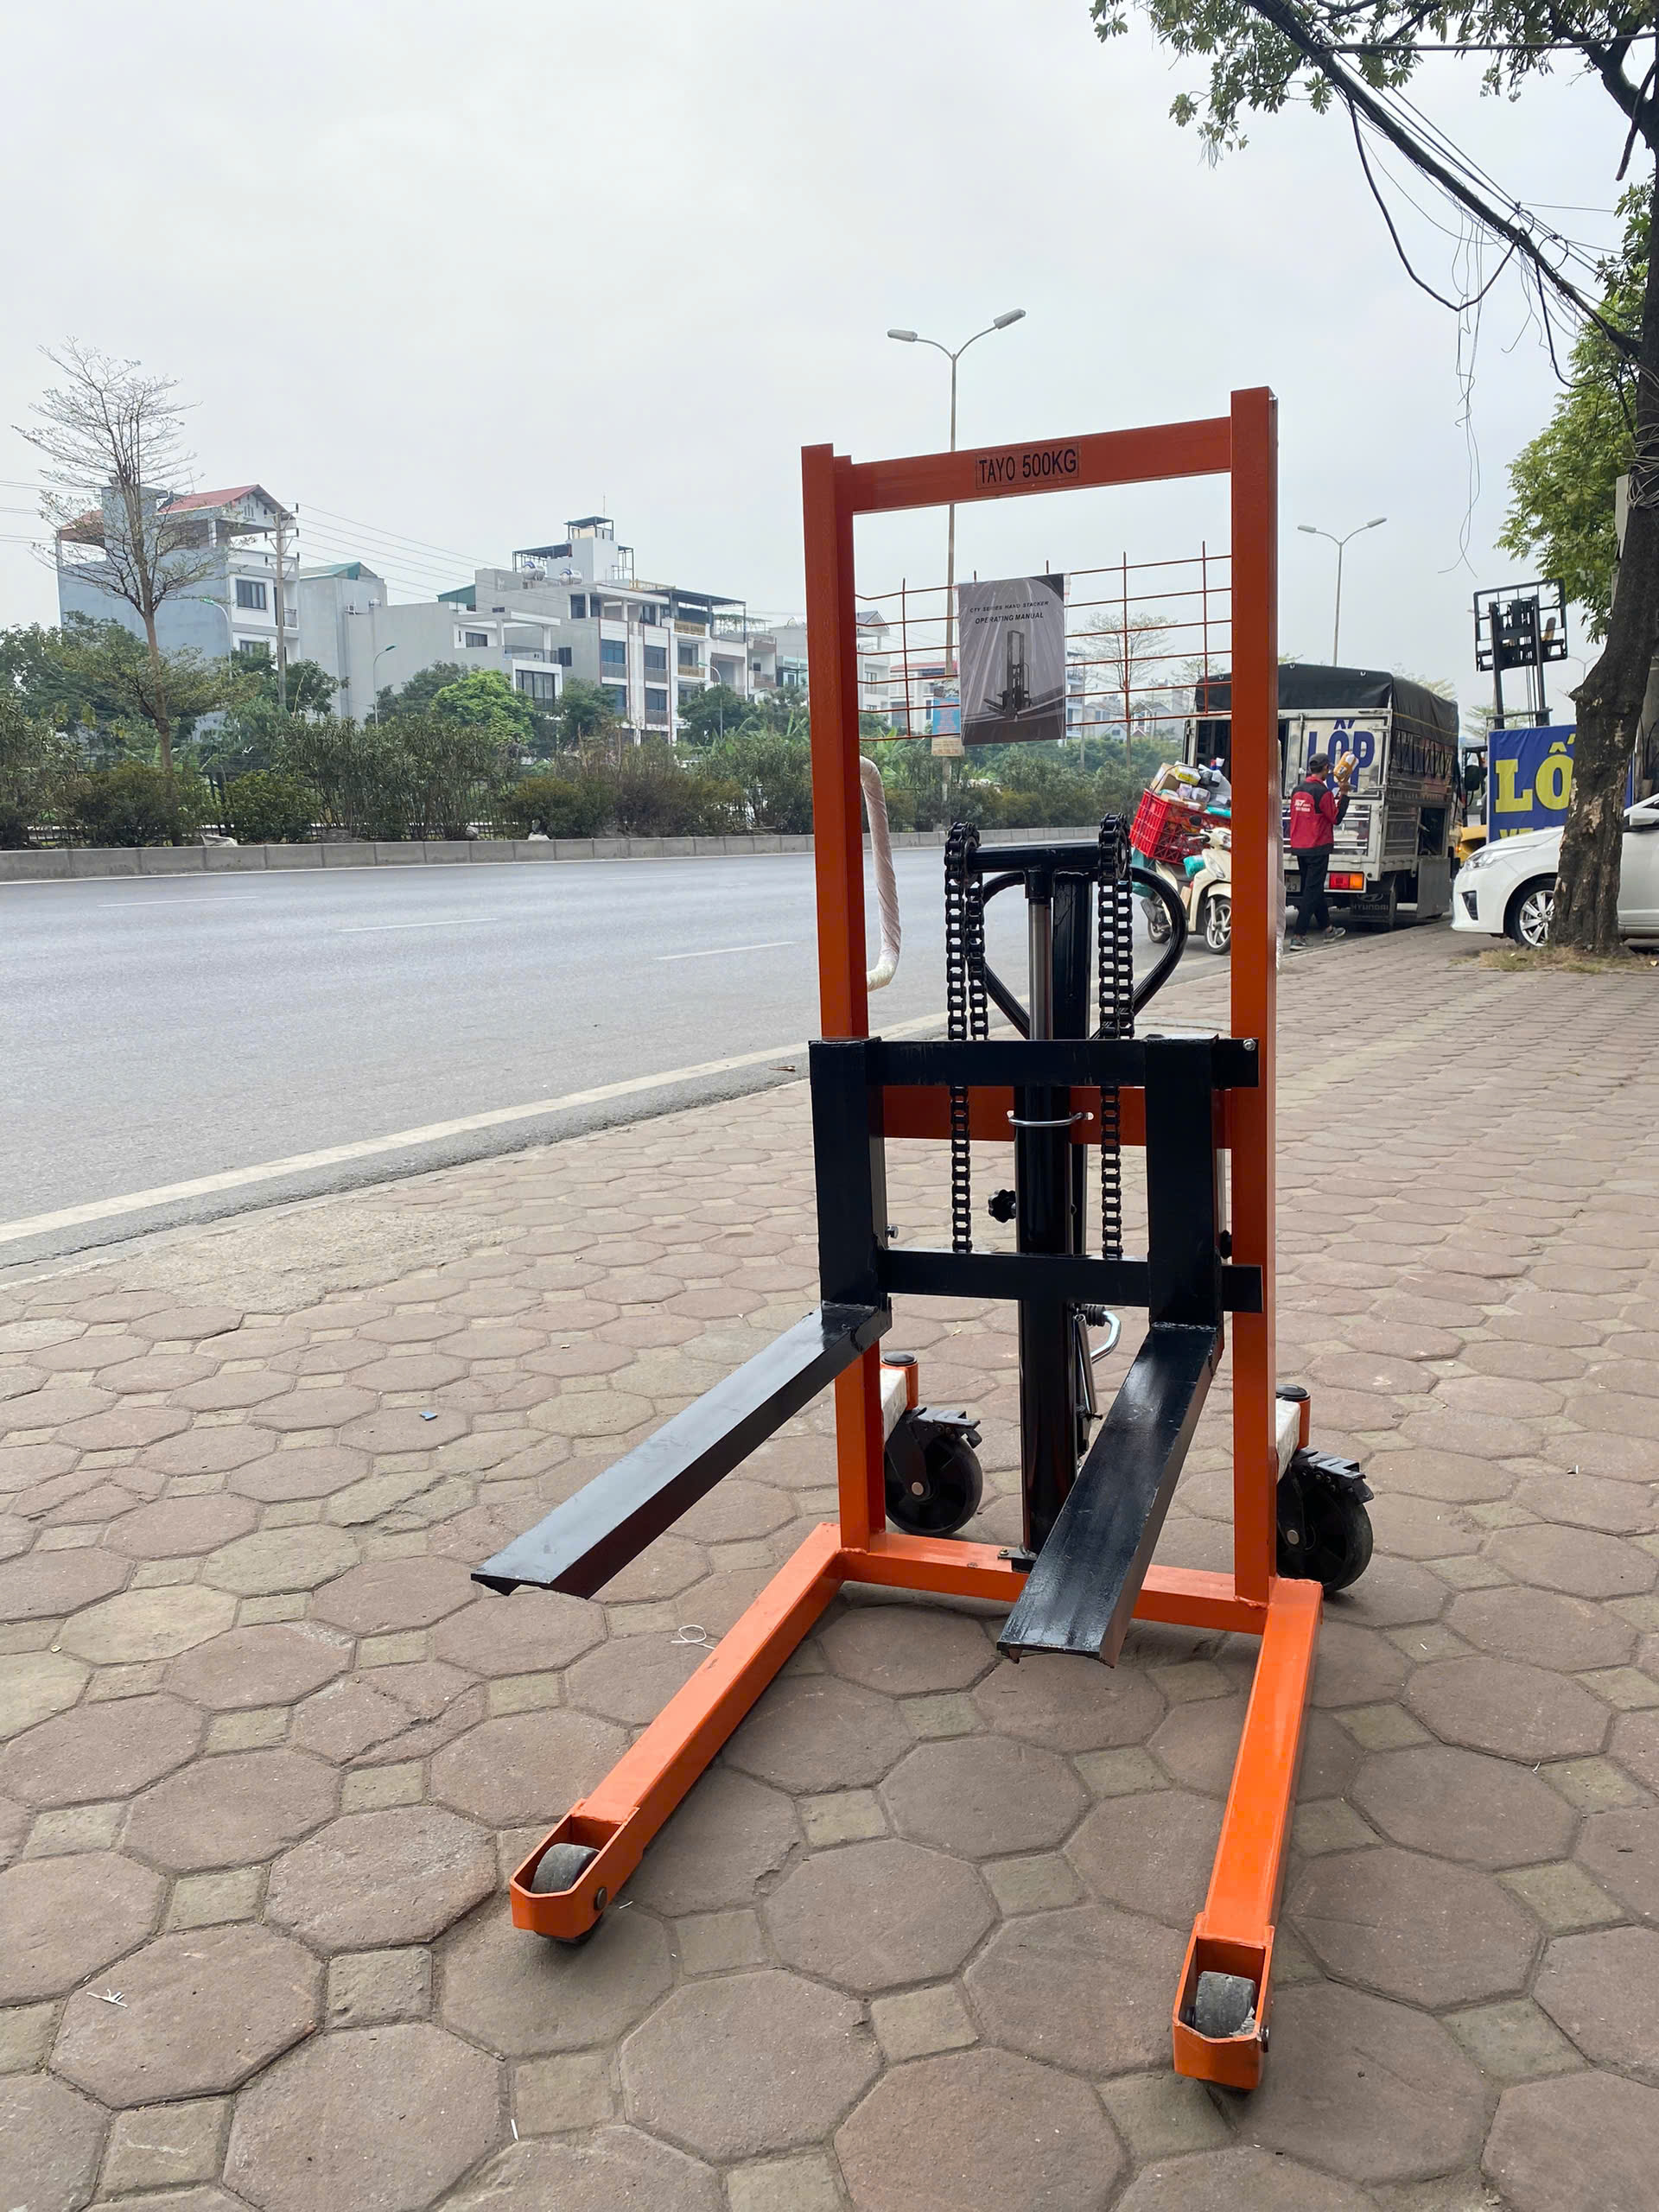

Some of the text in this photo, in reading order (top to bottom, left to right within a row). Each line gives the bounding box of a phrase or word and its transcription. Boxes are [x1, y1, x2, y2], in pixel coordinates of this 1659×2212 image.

[978, 448, 1077, 484] TAYO 500KG
[975, 612, 1044, 625] OPERATING MANUAL
[1495, 733, 1576, 813] LỐ
